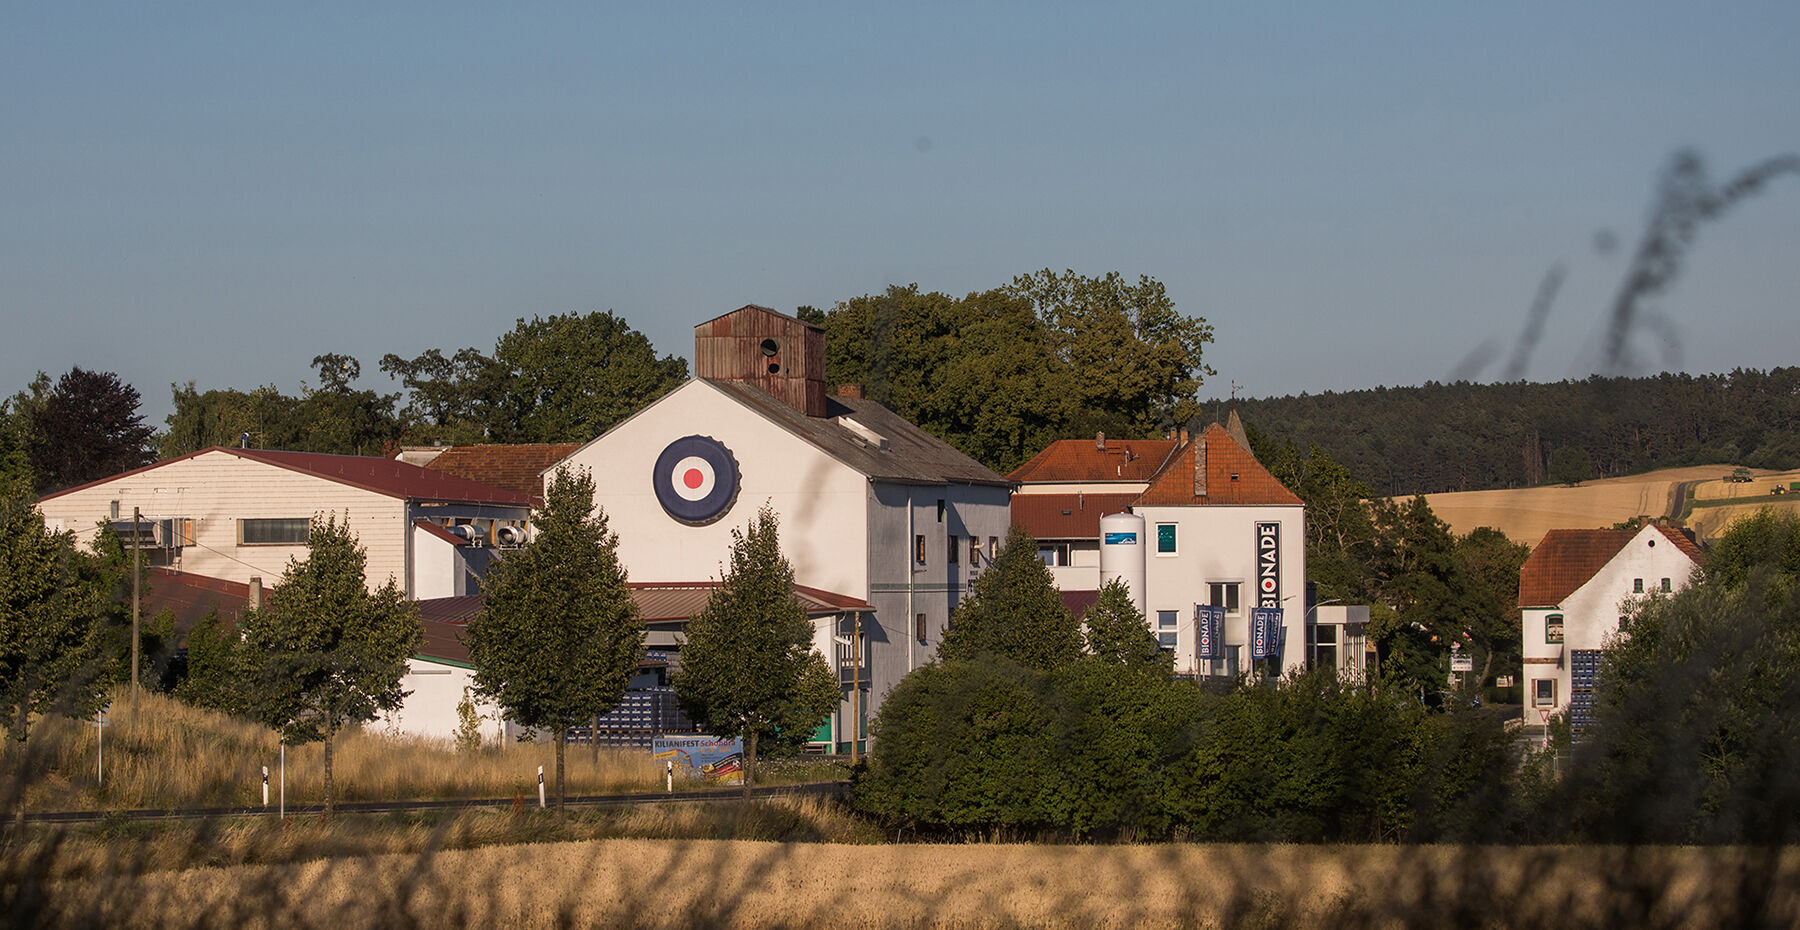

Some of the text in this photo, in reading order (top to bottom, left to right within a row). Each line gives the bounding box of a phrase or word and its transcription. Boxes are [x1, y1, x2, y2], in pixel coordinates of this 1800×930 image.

[1261, 526, 1277, 608] BIONADE
[1201, 612, 1210, 654] BIONADE
[1256, 615, 1265, 654] BIONADE
[655, 740, 699, 748] KILIANIFEST
